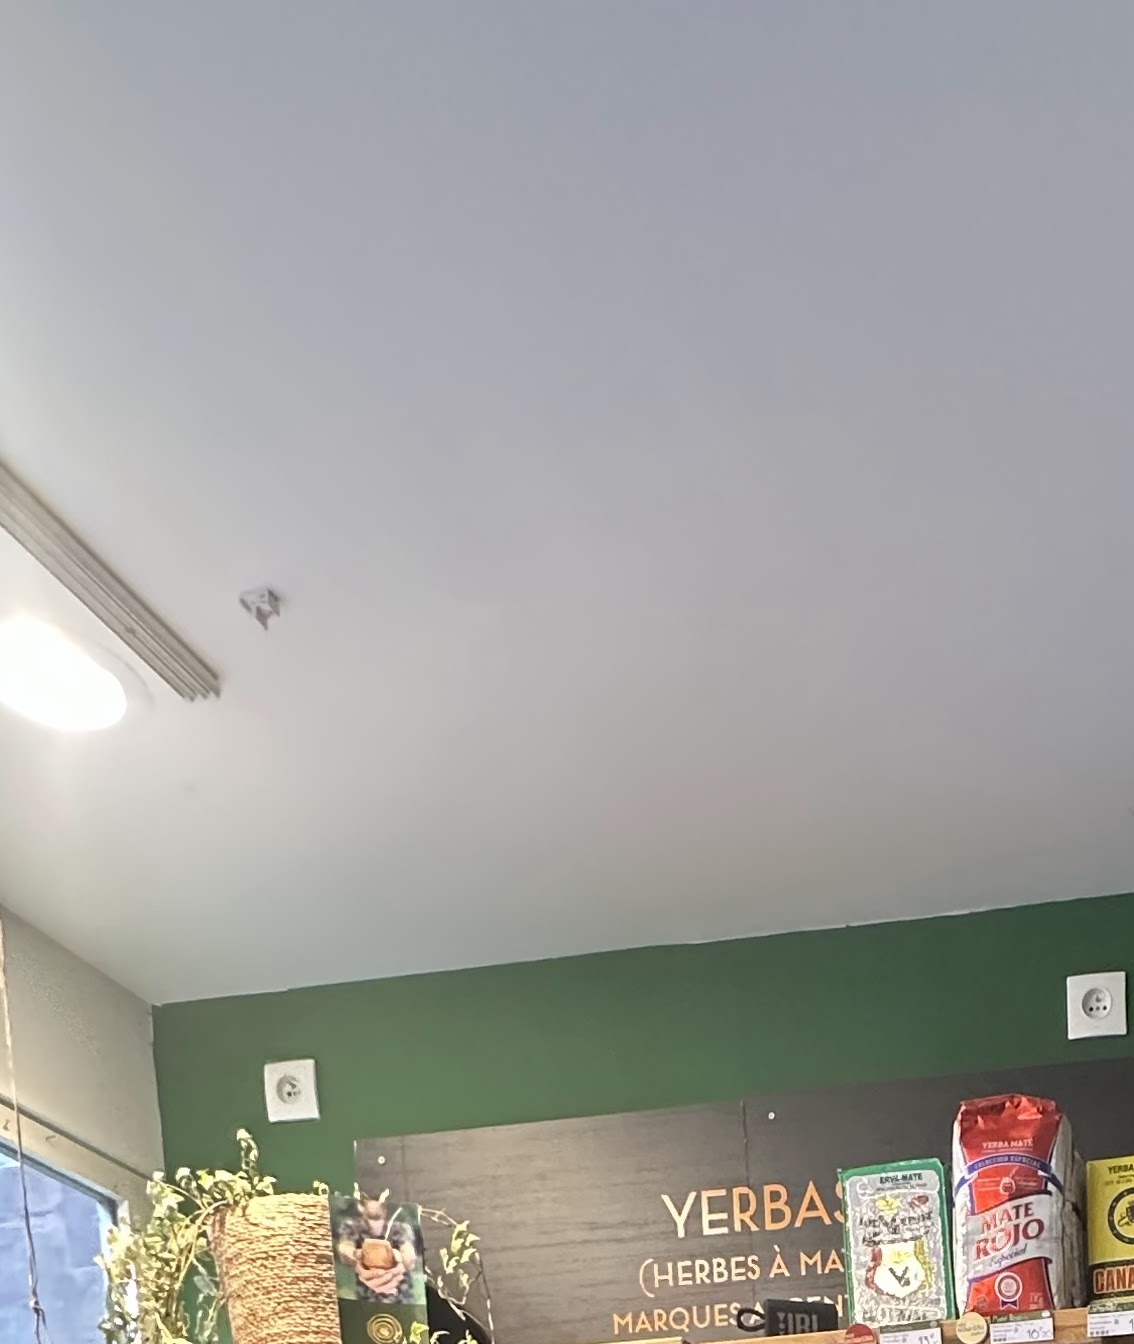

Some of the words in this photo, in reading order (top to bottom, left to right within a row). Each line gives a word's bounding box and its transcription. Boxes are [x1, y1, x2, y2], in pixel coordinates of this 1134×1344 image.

[1108, 1163, 1134, 1174] YERBA
[980, 1202, 1034, 1234] MATE
[975, 1218, 1045, 1260] ROJO
[639, 1255, 761, 1298] (HERBES
[769, 1244, 791, 1278] À
